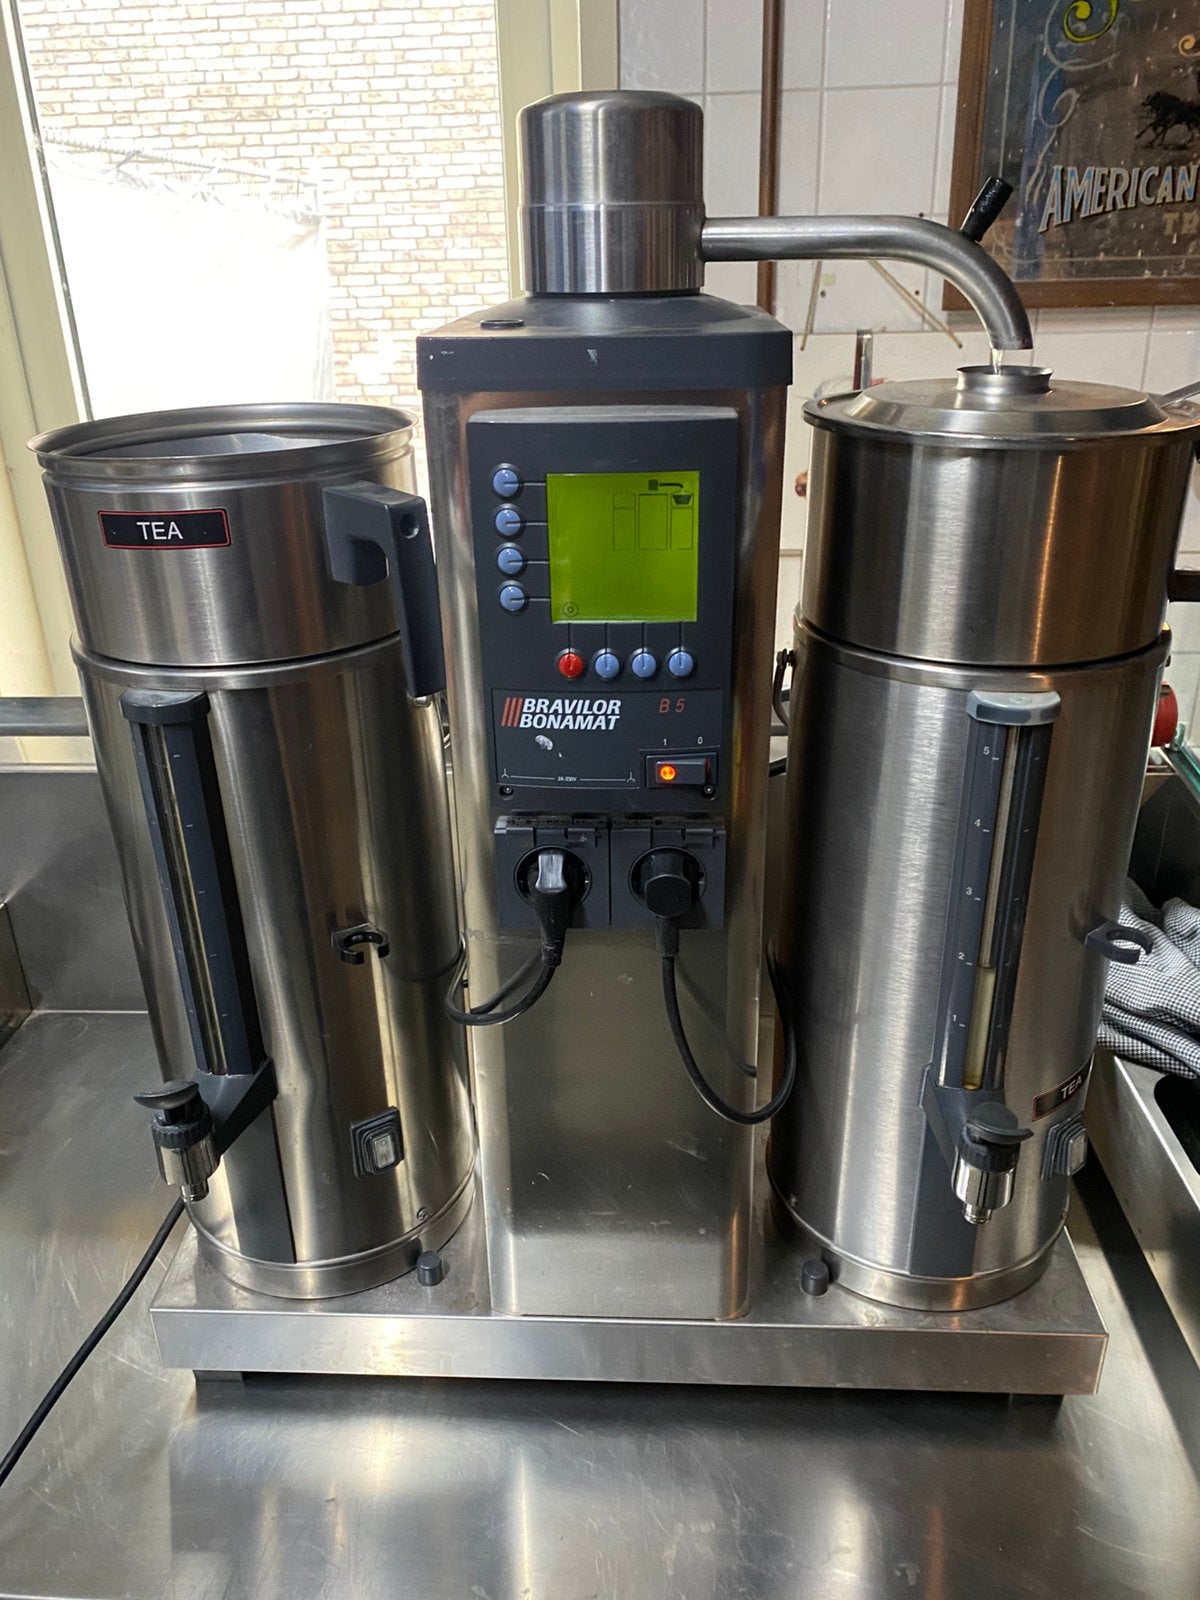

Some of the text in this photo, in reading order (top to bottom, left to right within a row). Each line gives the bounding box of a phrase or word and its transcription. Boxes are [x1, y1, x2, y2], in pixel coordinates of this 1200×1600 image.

[1038, 164, 1199, 233] AMERICAN
[136, 521, 184, 541] TEA
[522, 697, 622, 715] BRAVILOR
[519, 713, 620, 731] BONAMAT
[983, 746, 990, 755] 5
[974, 818, 981, 827] 4
[965, 886, 973, 896] 3
[958, 951, 965, 960] 2
[1061, 1075, 1082, 1099] TEA
